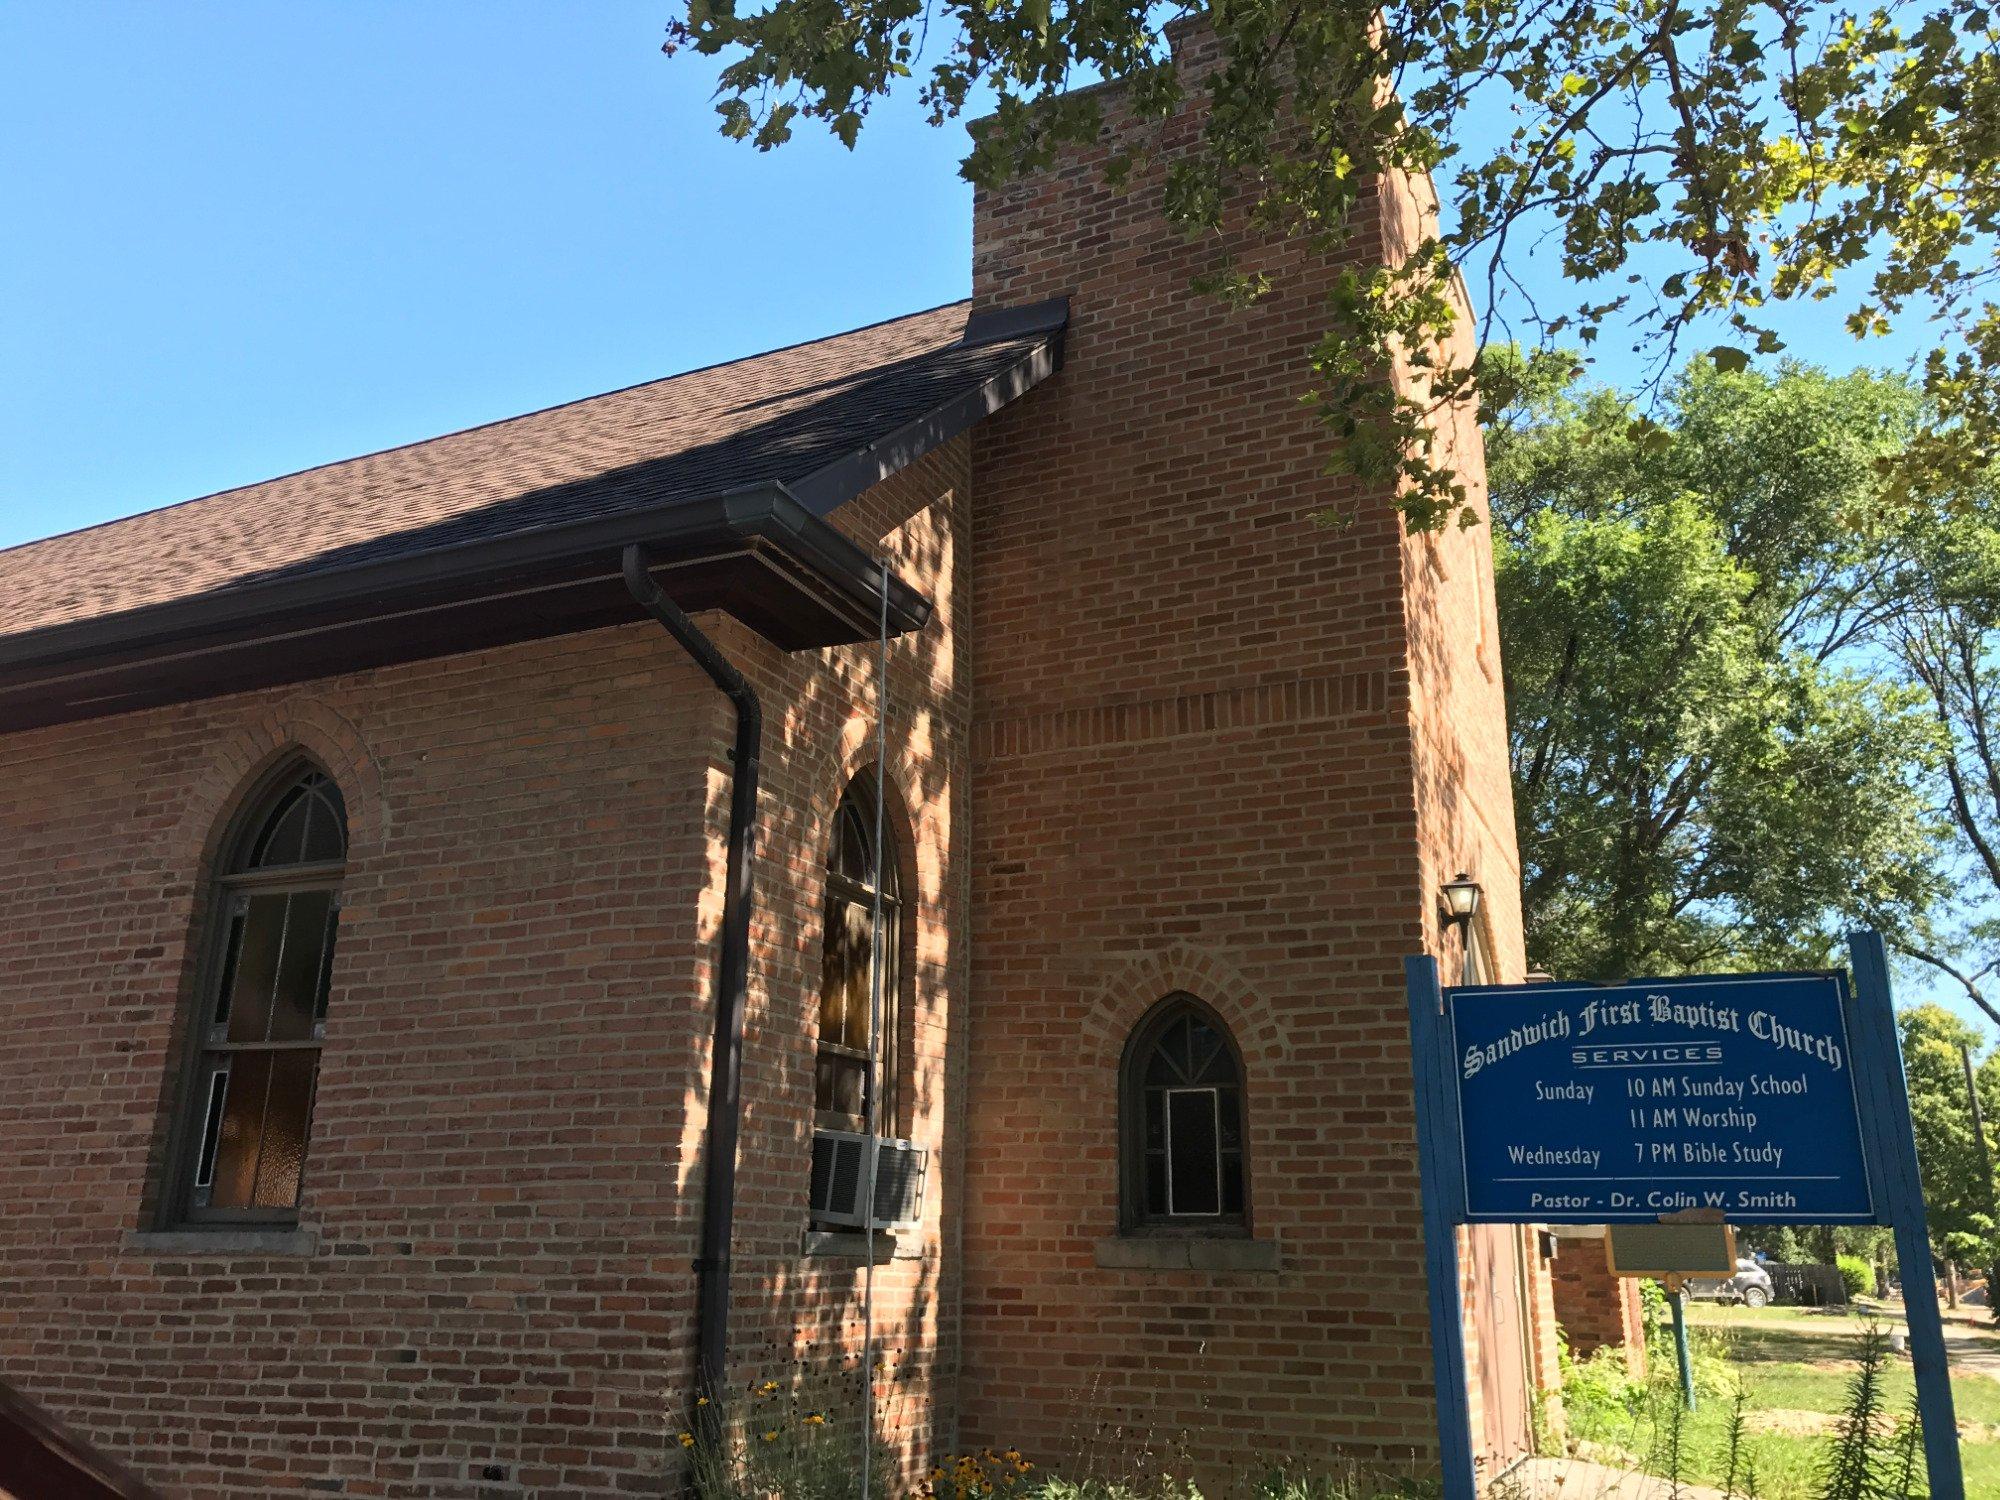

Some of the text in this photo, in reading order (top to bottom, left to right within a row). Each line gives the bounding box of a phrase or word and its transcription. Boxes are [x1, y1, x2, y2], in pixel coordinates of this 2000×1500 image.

[1463, 994, 1842, 1079] Sandwich First Baptist Church
[1572, 1046, 1722, 1064] SERVICES
[1535, 1073, 1808, 1103] Sunday 10 AM Sunday School
[1630, 1106, 1757, 1133] 11 AM Worship
[1507, 1141, 1783, 1170] Wednesday 7 PM Bible Study
[1531, 1193, 1590, 1208] Pastor
[1611, 1192, 1640, 1208] Dr.
[1647, 1191, 1697, 1208] Colin
[1703, 1191, 1731, 1207] W.
[1738, 1191, 1796, 1208] Smith
